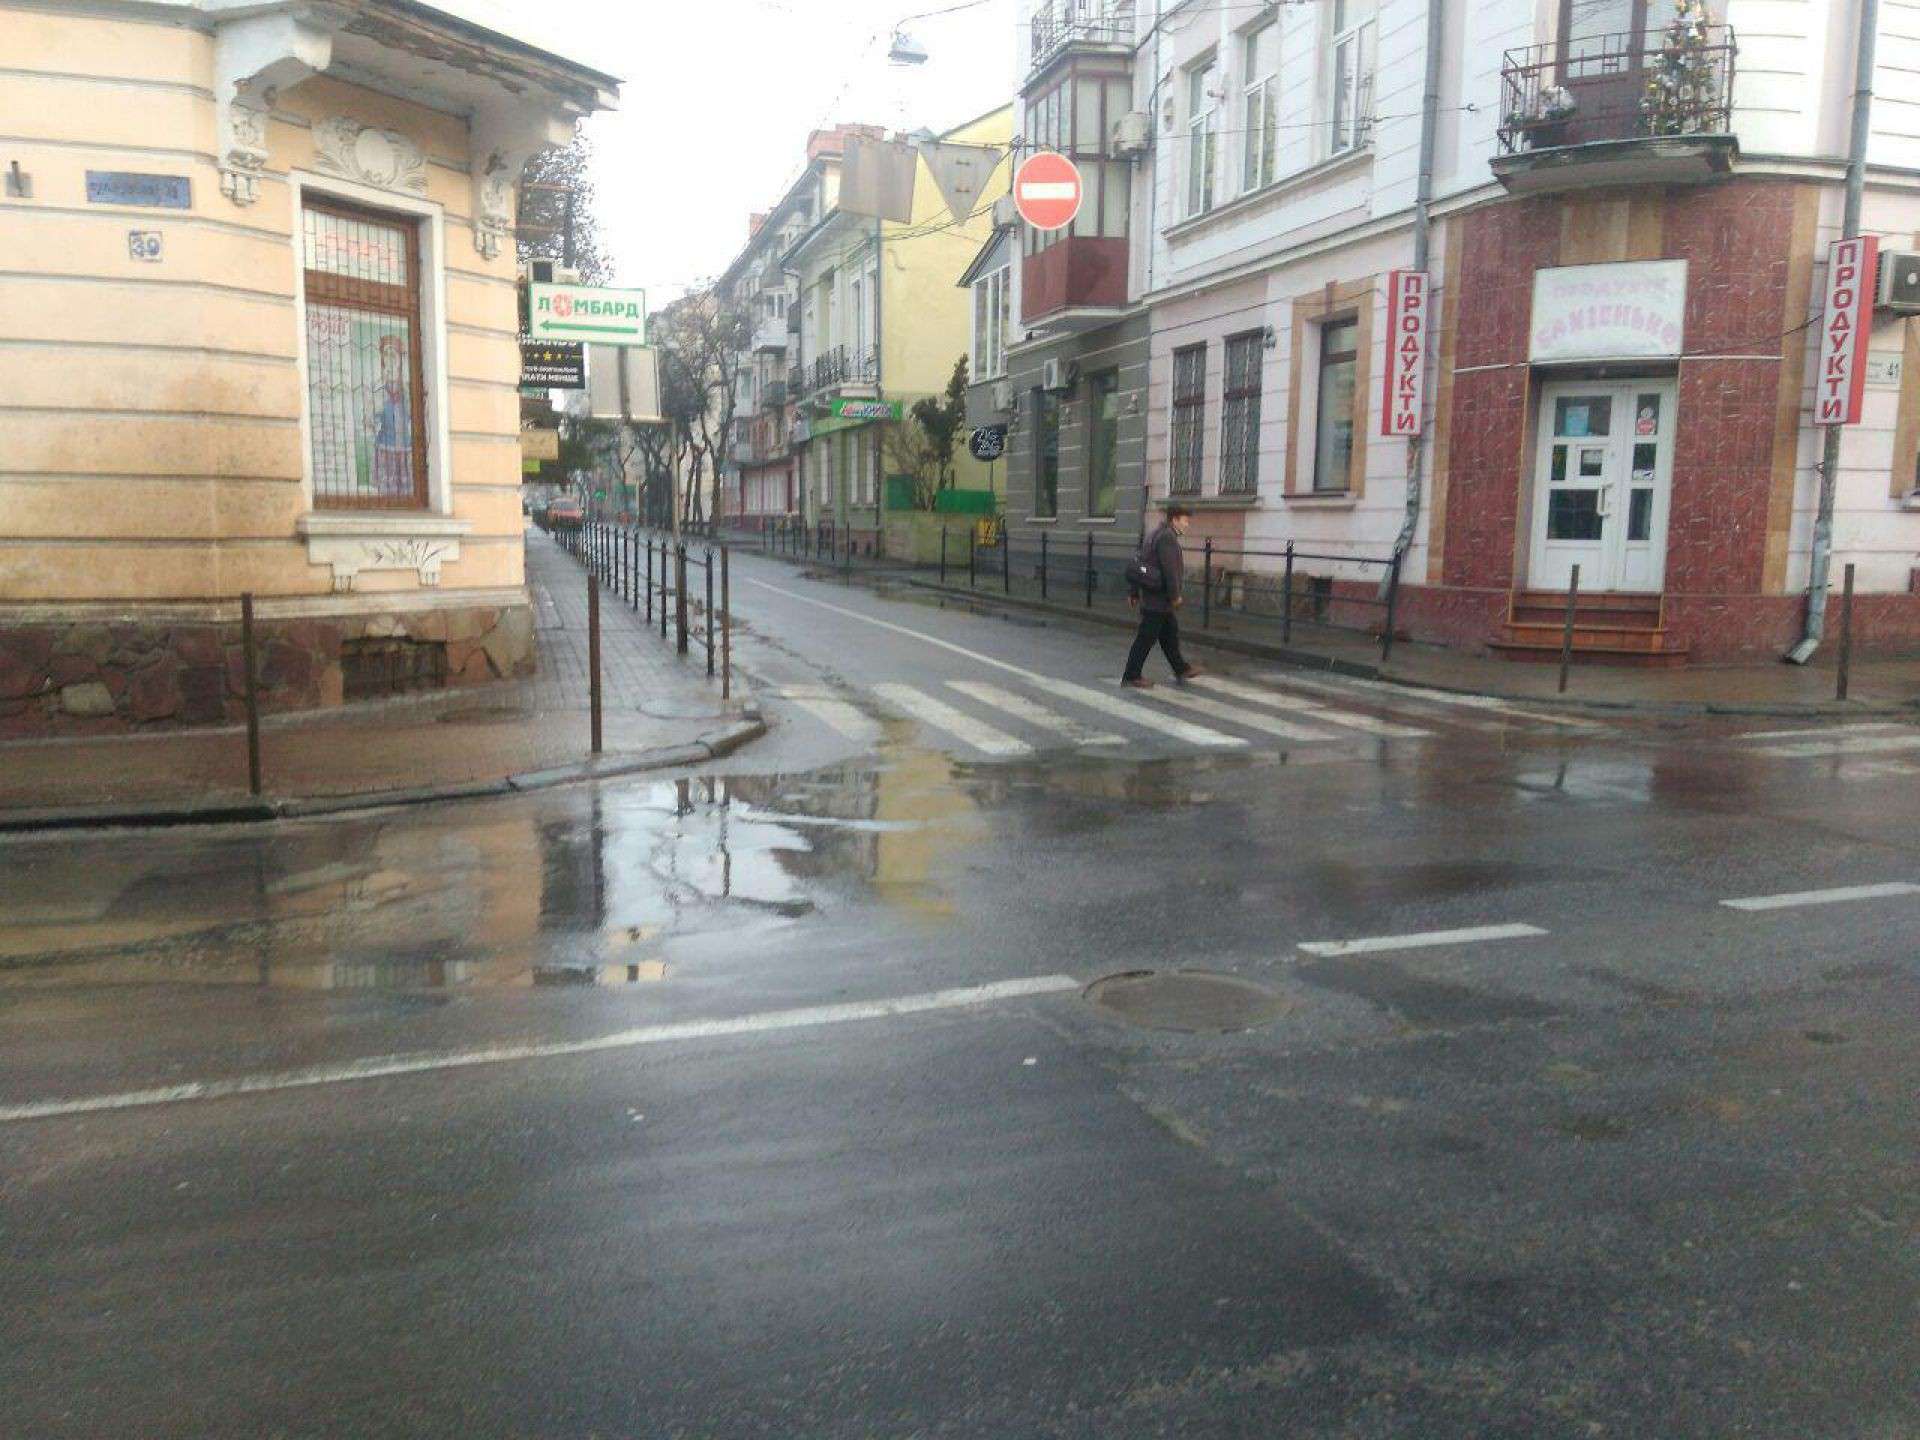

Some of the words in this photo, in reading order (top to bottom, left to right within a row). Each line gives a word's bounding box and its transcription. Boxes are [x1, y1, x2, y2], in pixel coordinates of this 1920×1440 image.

[538, 294, 639, 318] ЛОМБАРД
[1396, 275, 1422, 431] ПРОДУКТИ
[1823, 241, 1857, 419] ПРОДУКТИ
